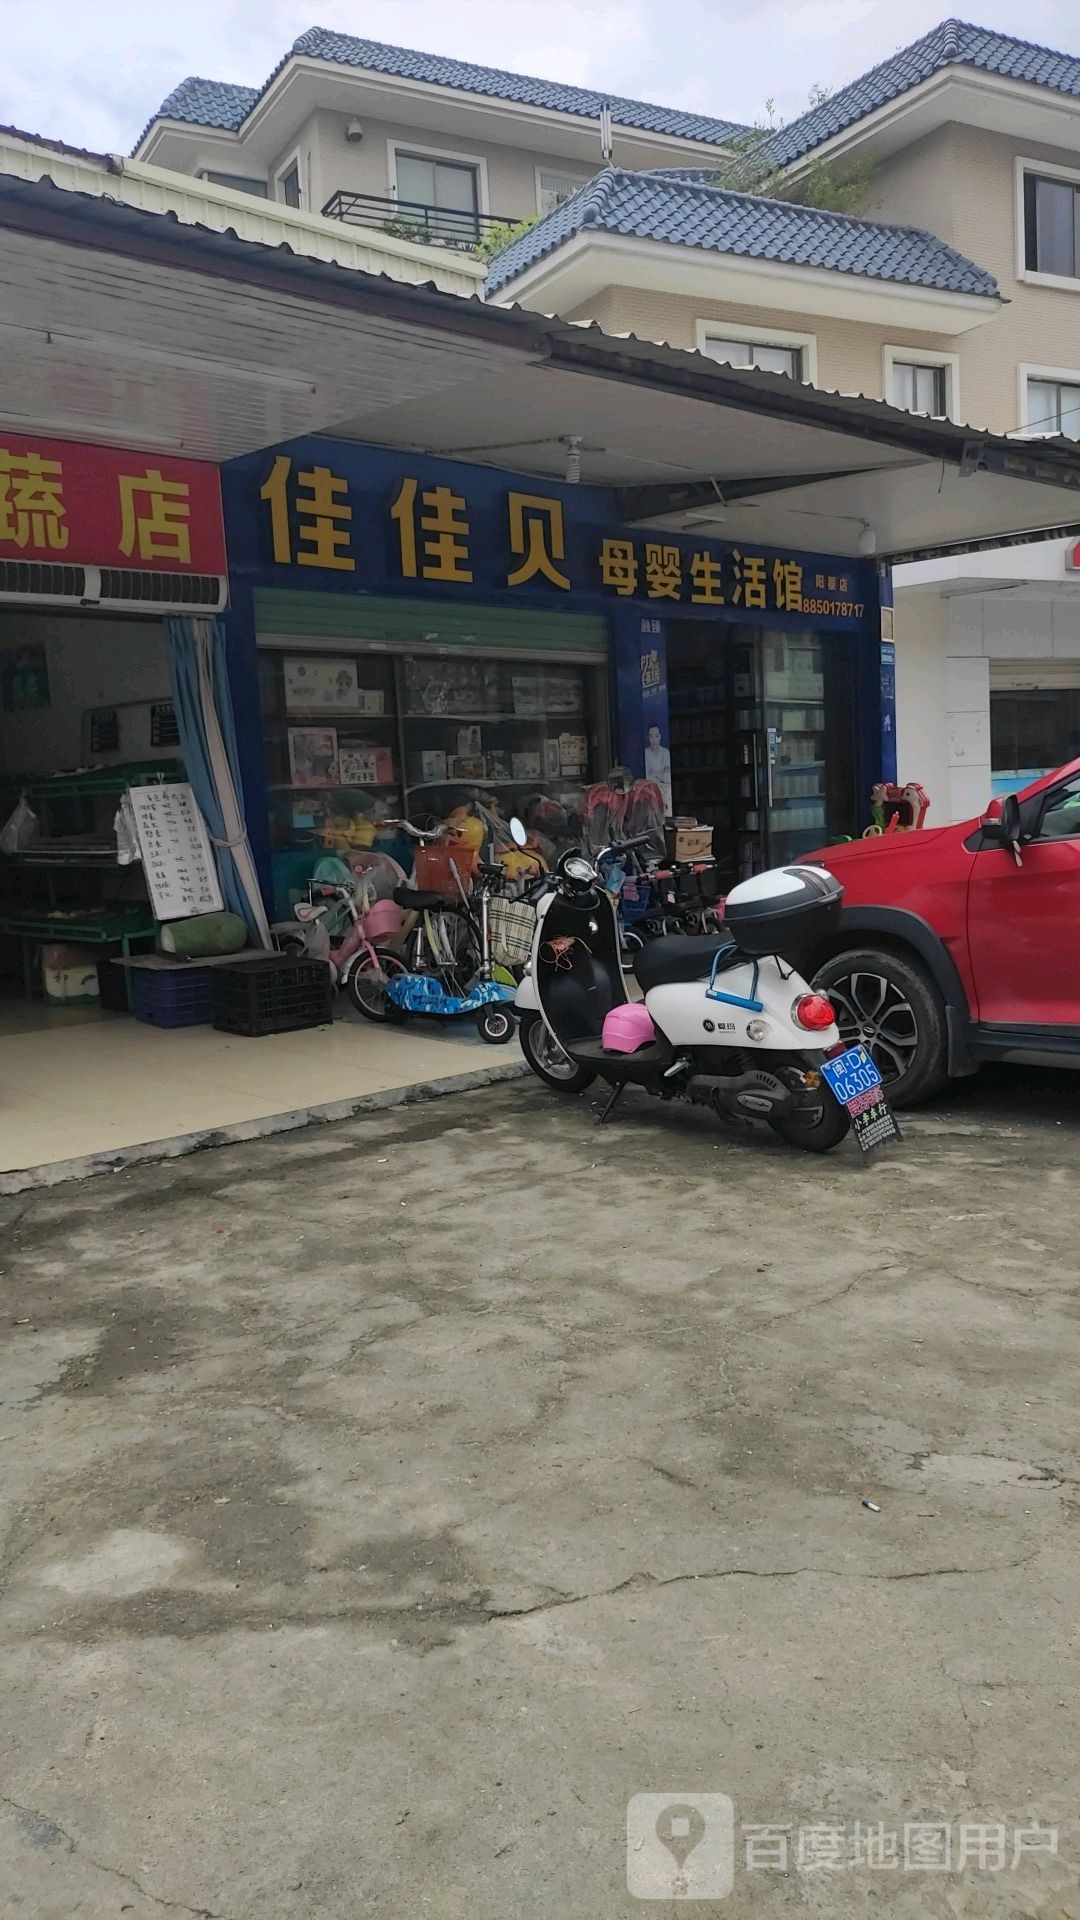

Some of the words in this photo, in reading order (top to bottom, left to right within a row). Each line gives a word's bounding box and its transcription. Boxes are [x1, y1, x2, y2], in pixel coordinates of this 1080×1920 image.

[260, 454, 572, 591] 佳佳贝
[599, 538, 803, 612] 母婴生活馆
[834, 1064, 879, 1101] 06305
